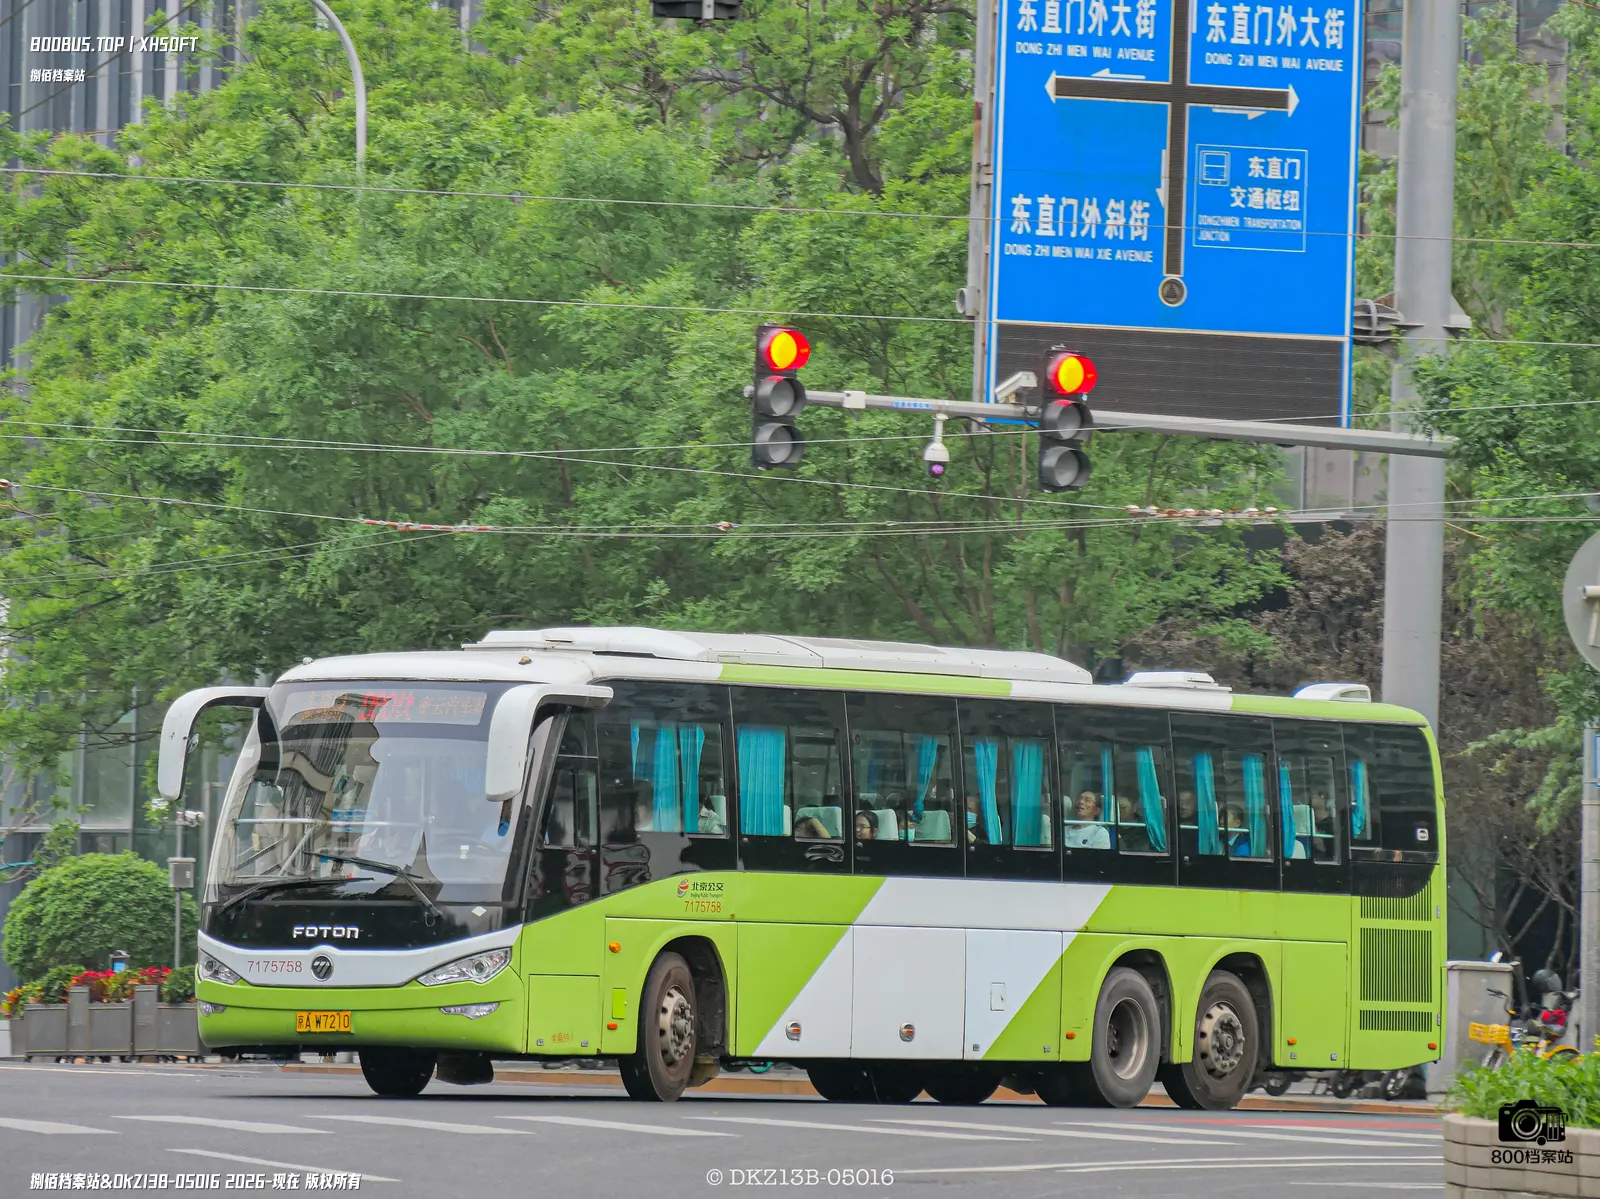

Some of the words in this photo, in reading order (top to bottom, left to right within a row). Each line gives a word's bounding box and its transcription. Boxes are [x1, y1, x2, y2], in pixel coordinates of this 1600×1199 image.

[1017, 0, 1157, 39] 东直门外大街
[1206, 2, 1345, 49] 东直门外大街
[1015, 41, 1043, 55] DONG
[1046, 43, 1063, 56] ZHI
[1066, 44, 1087, 57] MEN
[1093, 46, 1112, 58] WAI
[1117, 47, 1155, 61] AVENUE
[1205, 52, 1233, 65] DONG
[1238, 54, 1254, 66] ZHI
[1257, 55, 1278, 68] MEN
[1281, 56, 1301, 69] WAI
[1305, 58, 1344, 71] AVENUE
[1248, 156, 1301, 180] 东直门
[1230, 186, 1300, 211] 交通枢纽
[1010, 193, 1150, 241] 东直门外斜街
[1004, 243, 1032, 256] DONG
[1034, 245, 1050, 257] ZHI
[1052, 246, 1073, 258] MEN
[1075, 247, 1094, 259] WAI
[1096, 248, 1112, 260] XIE
[1115, 249, 1153, 262] AVENUE
[691, 881, 724, 891] 北京公交
[685, 900, 722, 913] 7175758
[293, 926, 360, 939] FOTON
[247, 960, 303, 973] 7175758
